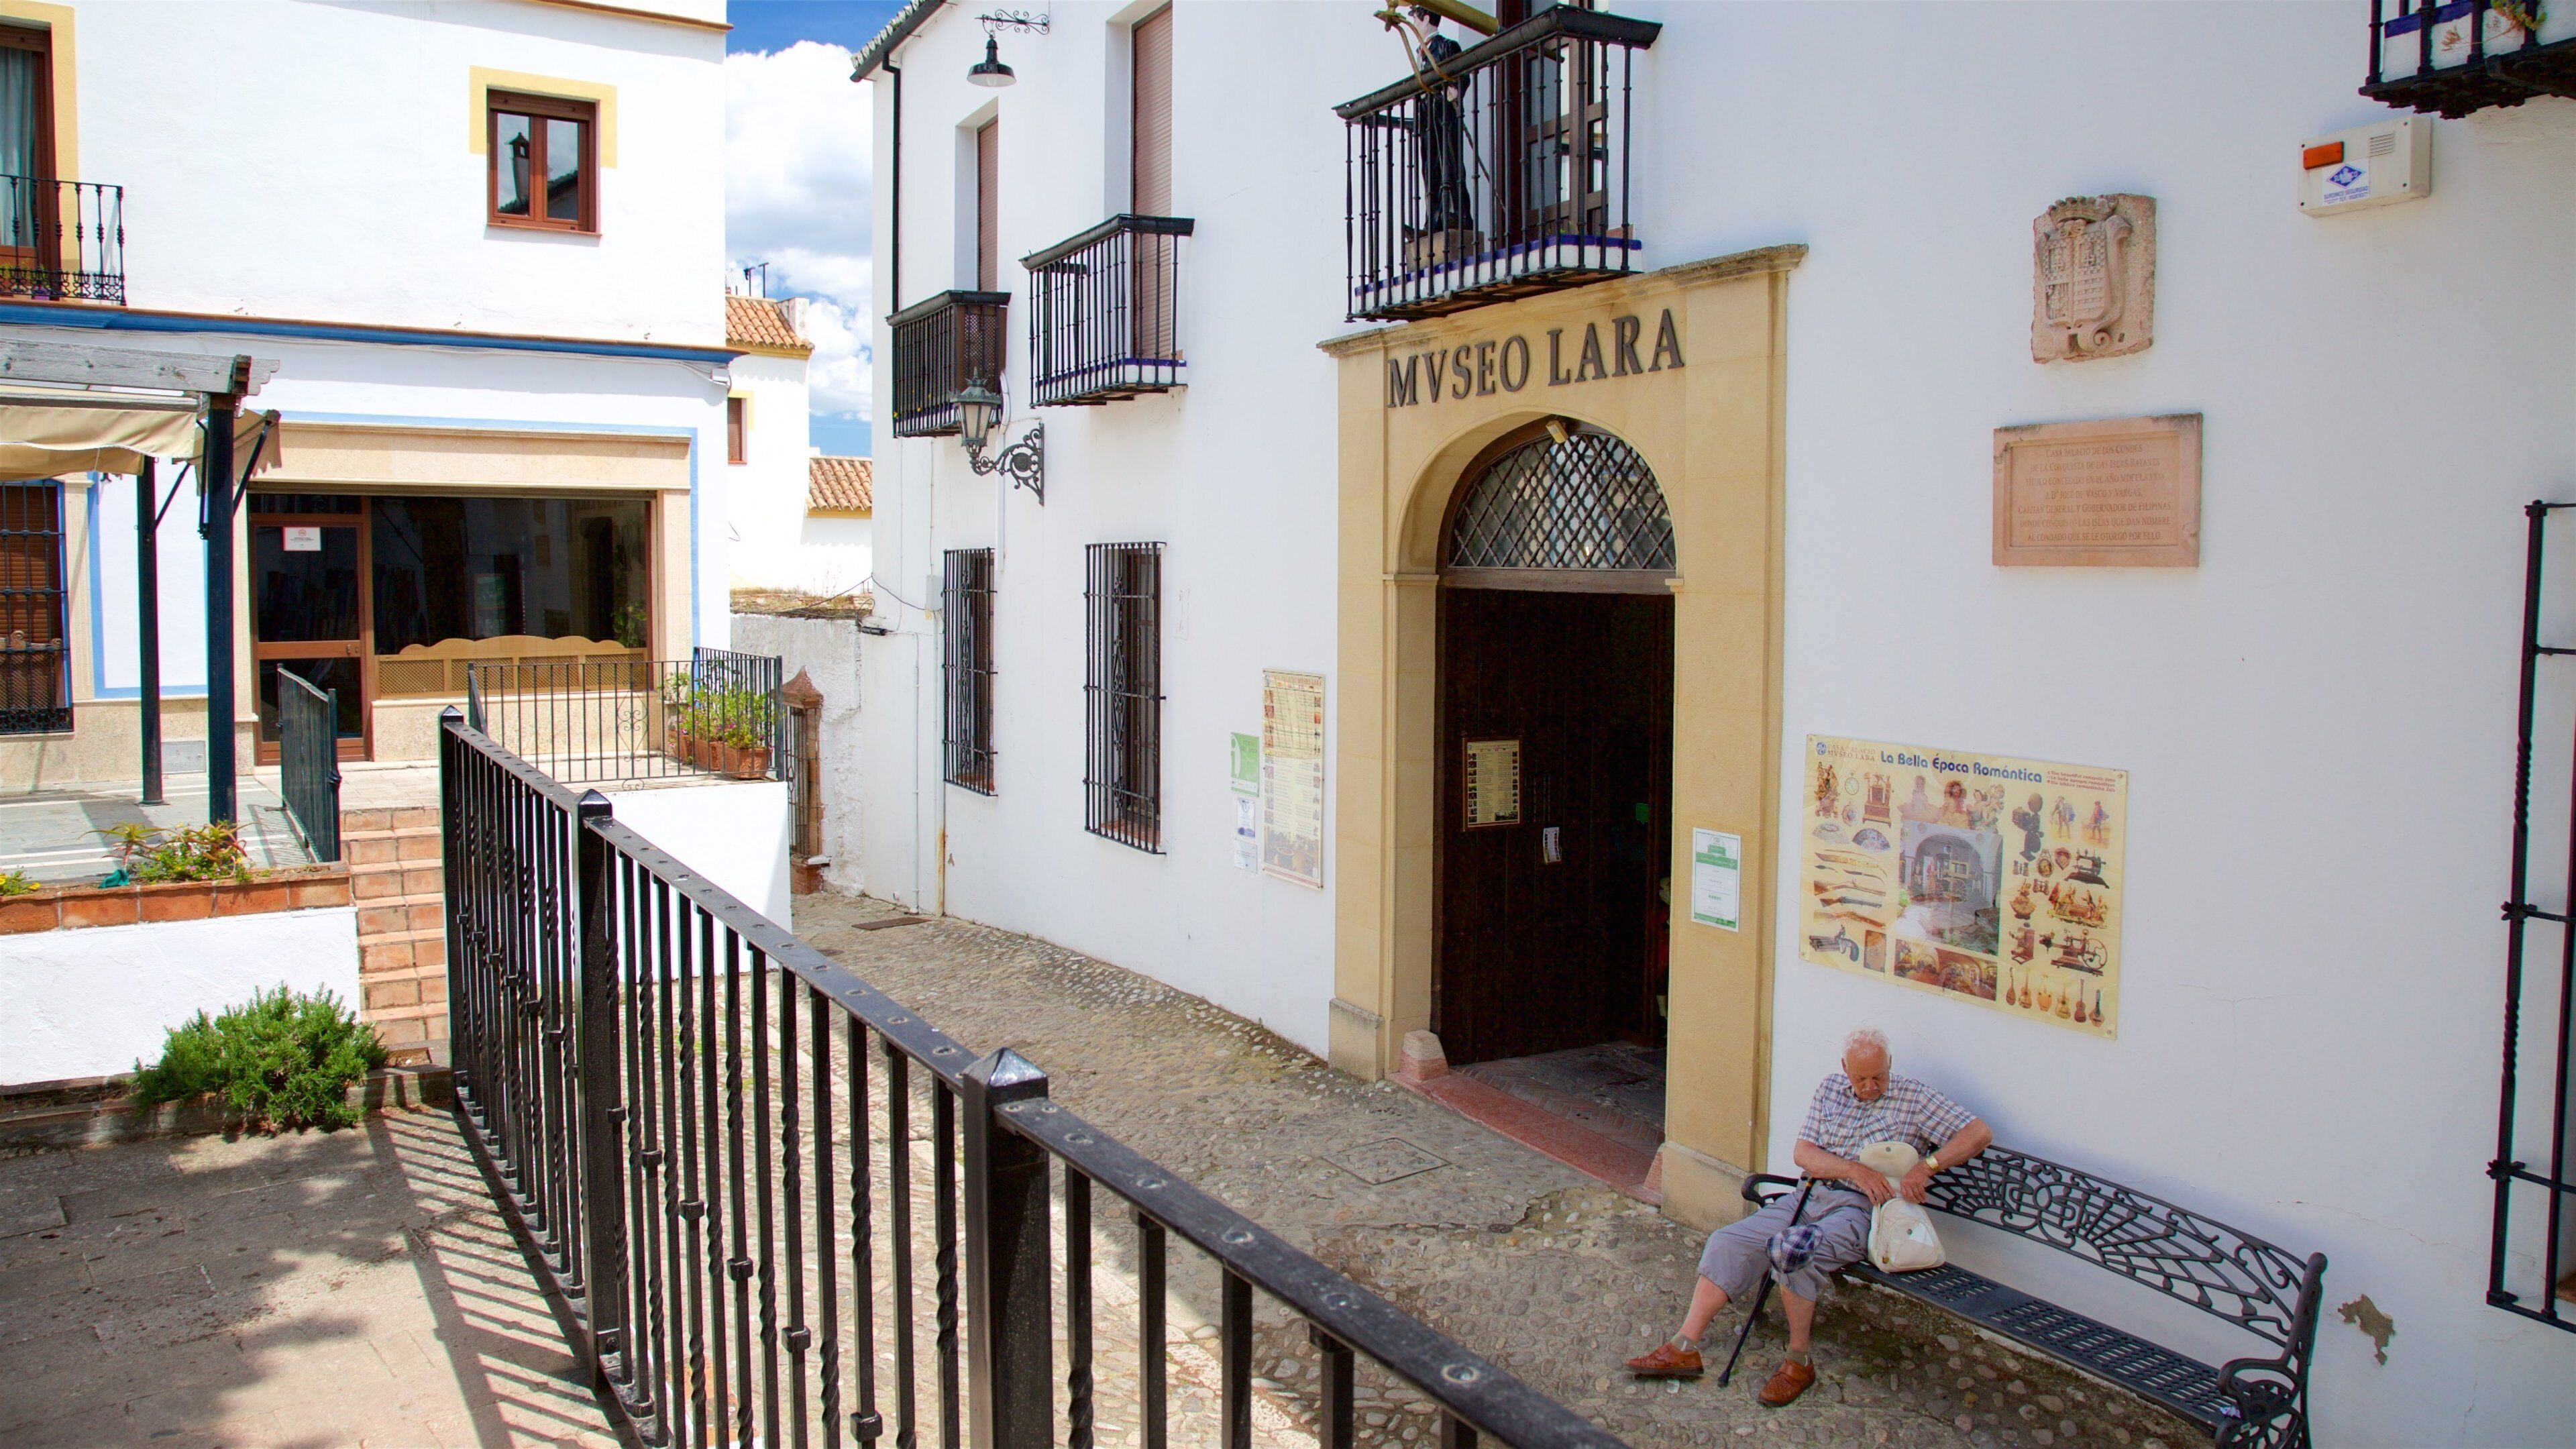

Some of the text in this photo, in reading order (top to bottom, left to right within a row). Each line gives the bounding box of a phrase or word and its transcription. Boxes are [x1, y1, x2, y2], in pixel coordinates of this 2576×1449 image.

[1388, 308, 1684, 408] MVSEO LARA
[2065, 447, 2091, 456] PALACIO
[2093, 446, 2100, 455] DE
[2102, 445, 2114, 455] LOS
[2116, 444, 2143, 453] CONDES
[2031, 458, 2160, 472] DE LA CONQUISTA DE LAS ISLAS BATANES
[2049, 476, 2084, 486] CONCEDIDO
[2086, 475, 2094, 484] EN
[2096, 475, 2103, 484] EL
[2106, 473, 2119, 483] AÑO
[2076, 490, 2084, 498] DE
[2086, 489, 2106, 498] VASCO
[2046, 504, 2075, 513] GENERAL
[2076, 504, 2080, 513] Y
[2082, 502, 2126, 513] GOBERNADOR
[2128, 502, 2137, 511] DE
[2020, 519, 2041, 528] DONDE
[2078, 518, 2090, 527] LAS
[2092, 517, 2110, 527] ISLAS
[2111, 517, 2126, 527] QUE
[2127, 517, 2141, 526] DAN
[2142, 516, 2171, 525] NOMBRE
[2027, 533, 2036, 541] AL
[2037, 532, 2066, 541] CONDADO
[2068, 532, 2081, 541] QUE
[2082, 532, 2090, 541] SE
[2092, 532, 2100, 541] LE
[2129, 532, 2142, 540] POR
[1881, 751, 2042, 783] La Bella Época Romántica
